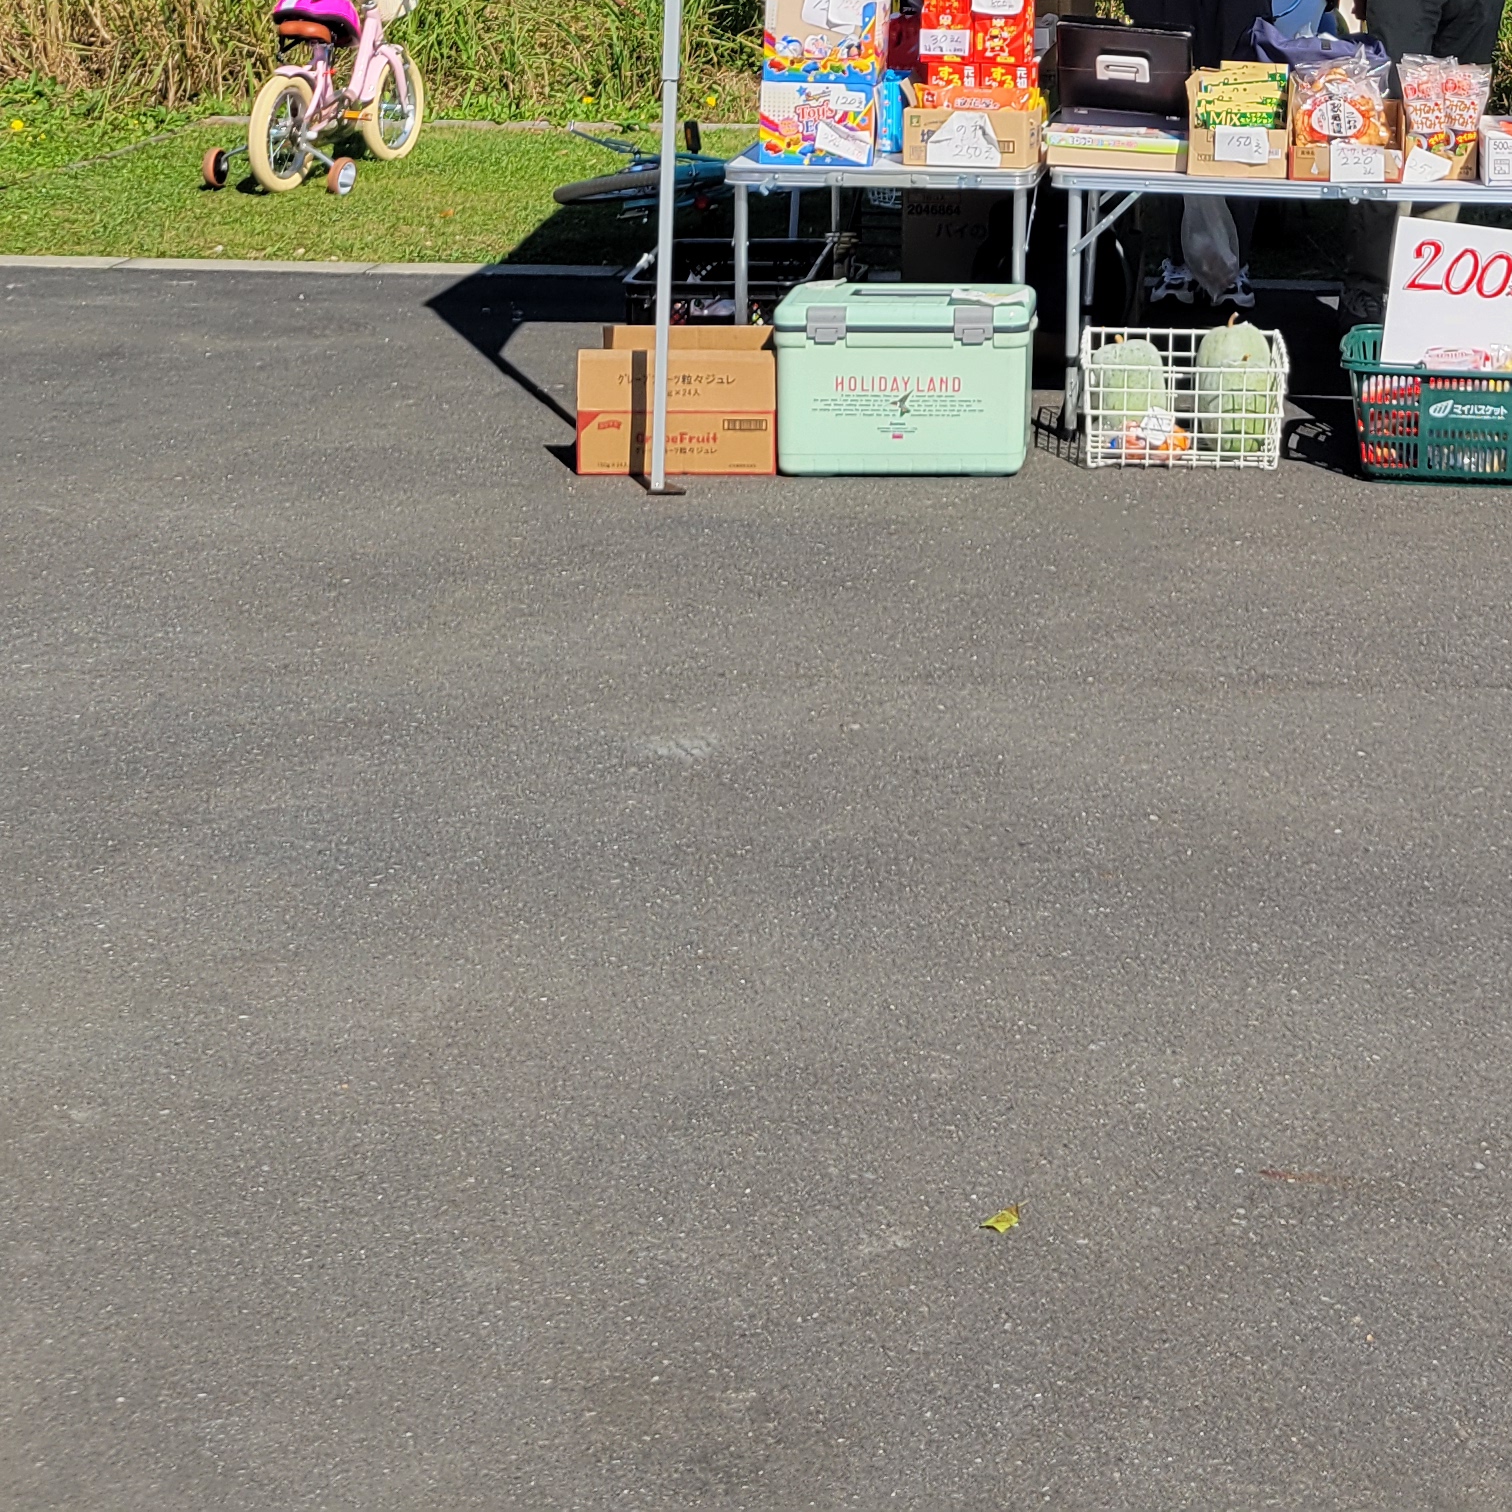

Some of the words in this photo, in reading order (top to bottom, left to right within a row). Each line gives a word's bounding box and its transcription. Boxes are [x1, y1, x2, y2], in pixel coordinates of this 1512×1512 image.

[796, 100, 836, 121] Toy's
[1210, 109, 1240, 125] Mix
[1493, 141, 1508, 150] 500
[1341, 157, 1373, 166] 220
[907, 204, 961, 215] 2046864
[1453, 403, 1508, 415] マイバスケット
